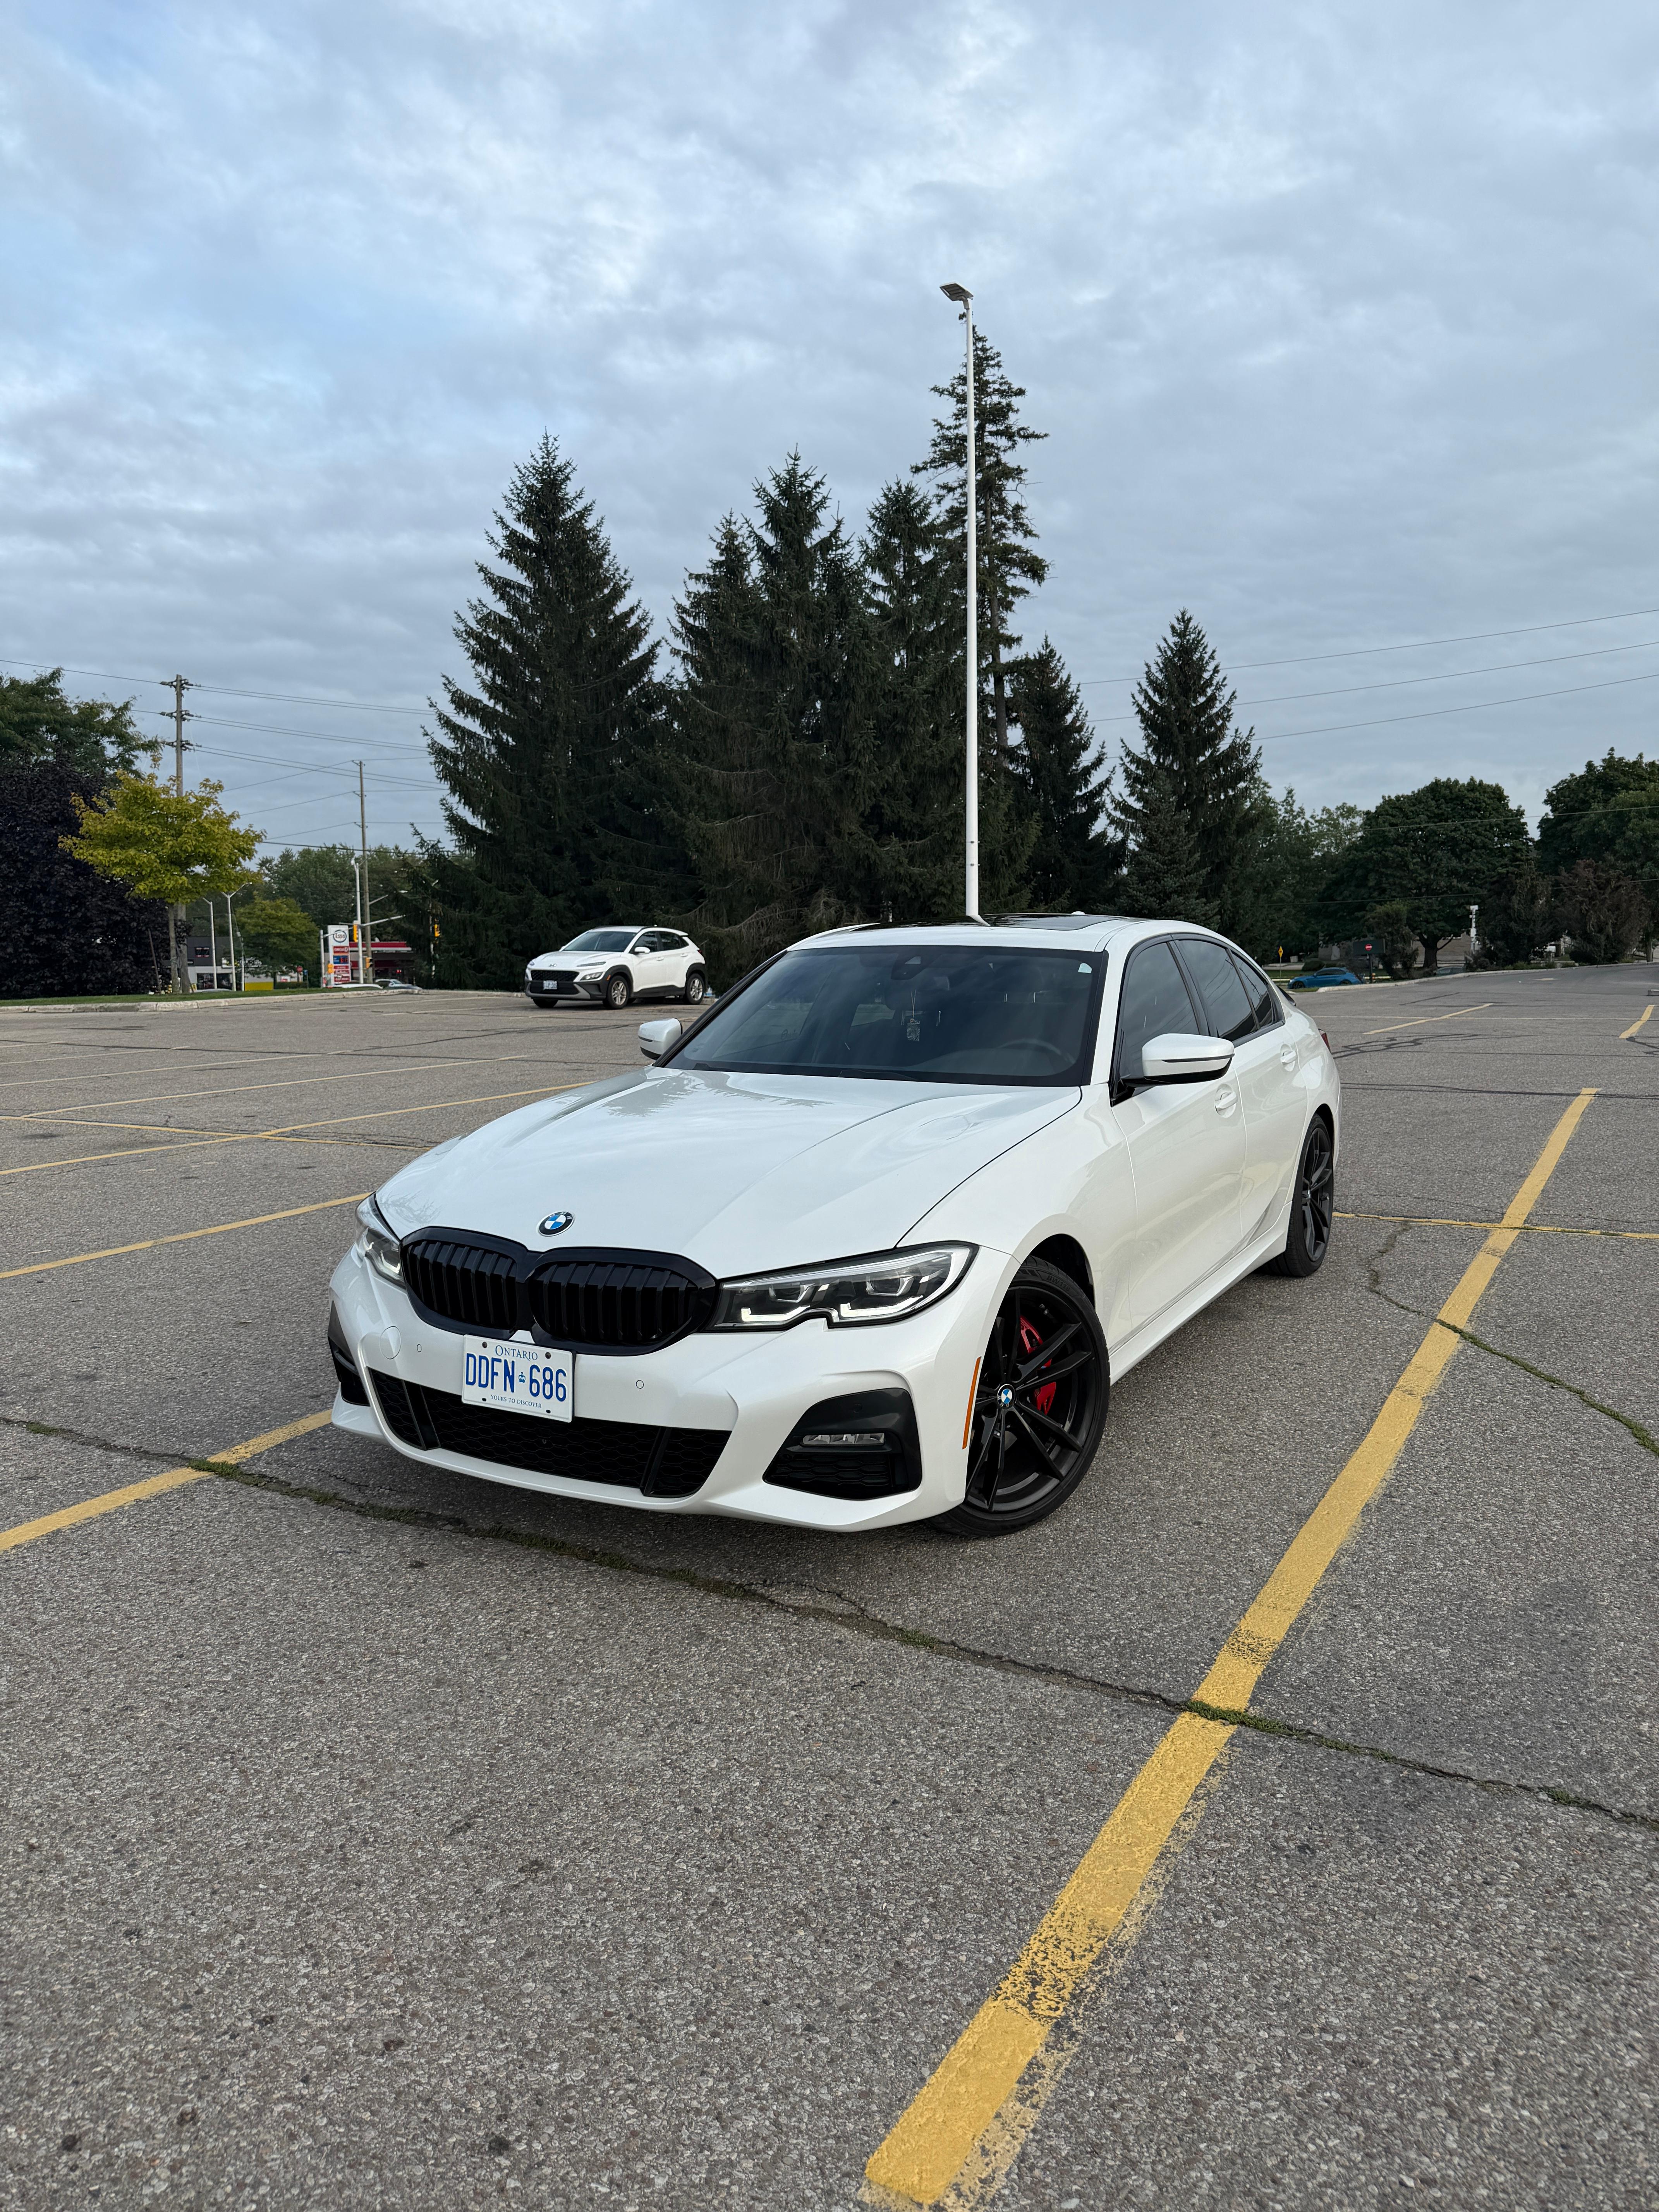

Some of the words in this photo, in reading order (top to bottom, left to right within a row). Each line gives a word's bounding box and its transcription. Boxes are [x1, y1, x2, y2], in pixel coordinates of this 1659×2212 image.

[495, 1345, 538, 1361] ONTARIO
[466, 1353, 515, 1393] DDFN
[529, 1364, 567, 1402] 686
[517, 1400, 542, 1408] DISCOVER
